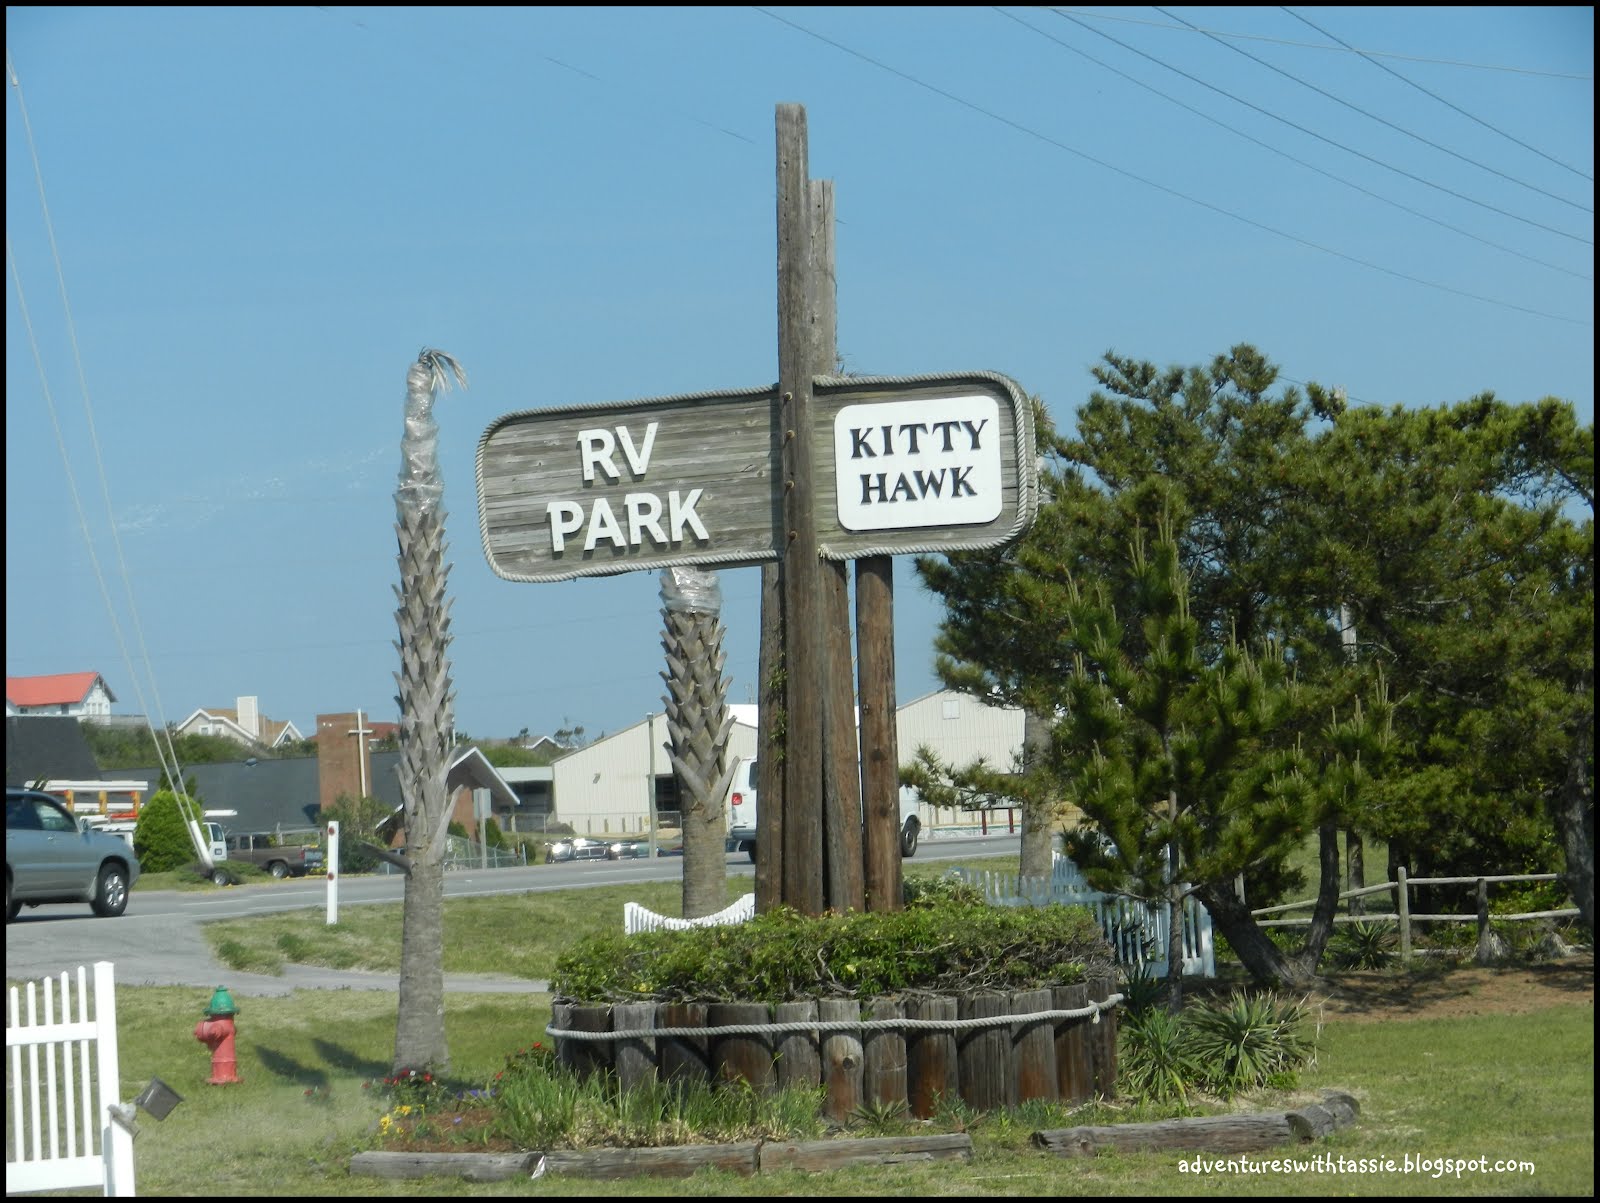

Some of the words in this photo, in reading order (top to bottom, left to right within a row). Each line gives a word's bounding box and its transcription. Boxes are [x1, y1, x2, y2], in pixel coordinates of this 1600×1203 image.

[577, 423, 658, 480] RV
[850, 419, 988, 459] KITTY
[860, 466, 977, 505] HAWK
[547, 489, 709, 552] PARK
